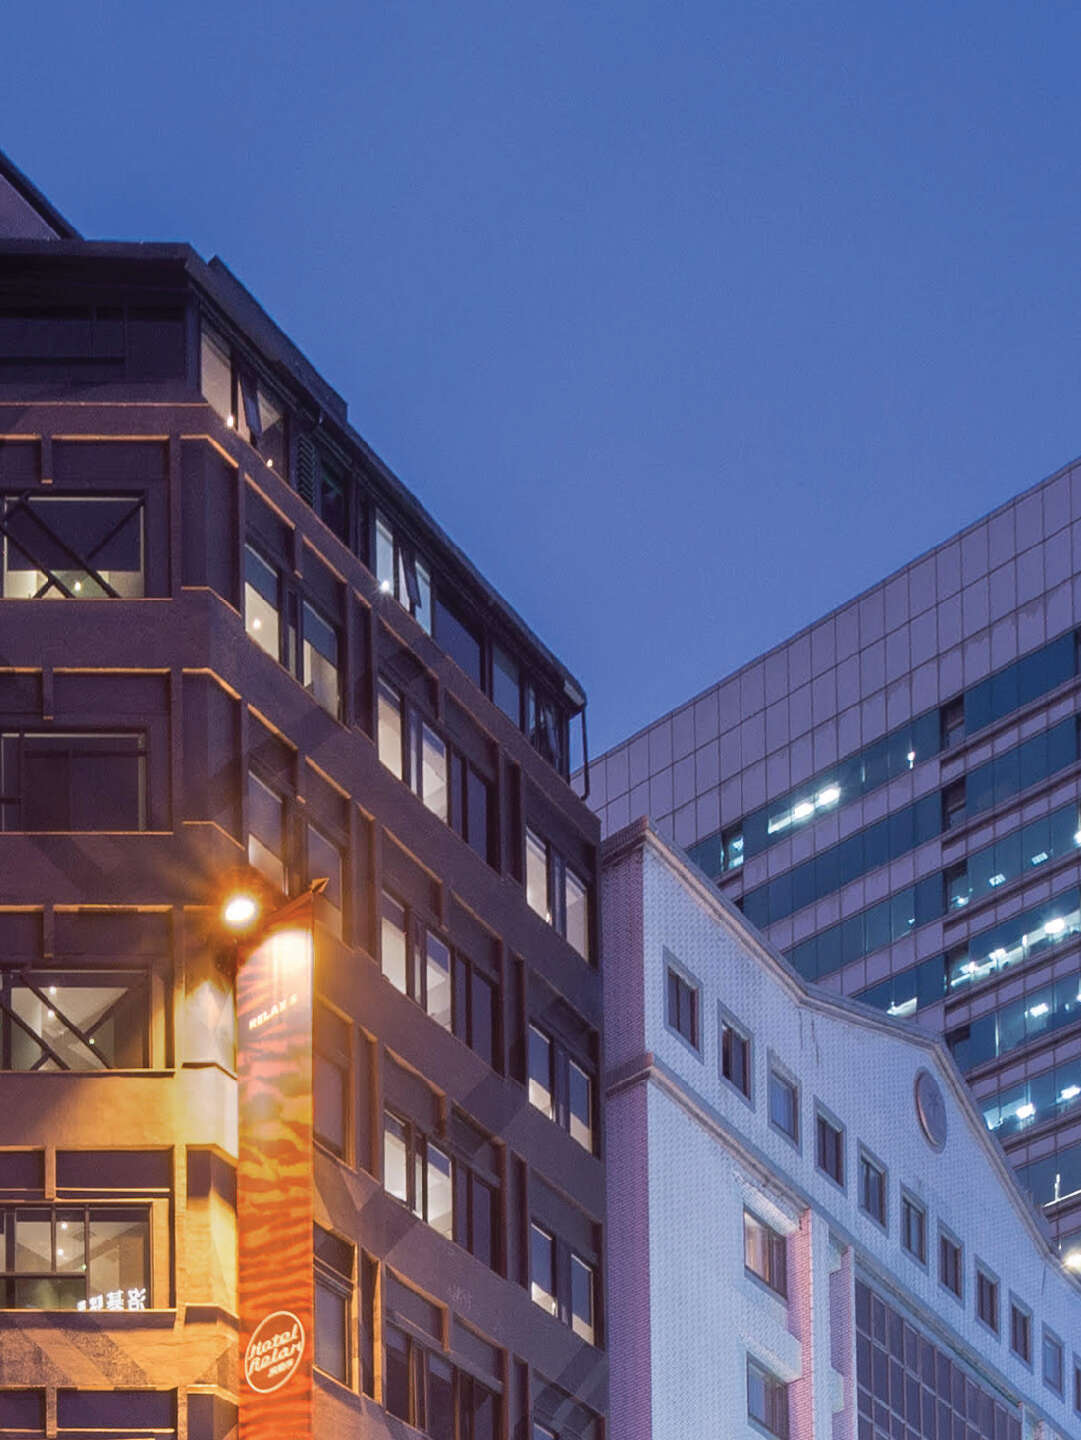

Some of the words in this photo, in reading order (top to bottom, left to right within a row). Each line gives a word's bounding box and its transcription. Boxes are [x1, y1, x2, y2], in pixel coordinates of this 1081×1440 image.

[248, 999, 287, 1031] RELAX
[248, 1323, 298, 1361] Hotel
[248, 1341, 302, 1376] Relax
